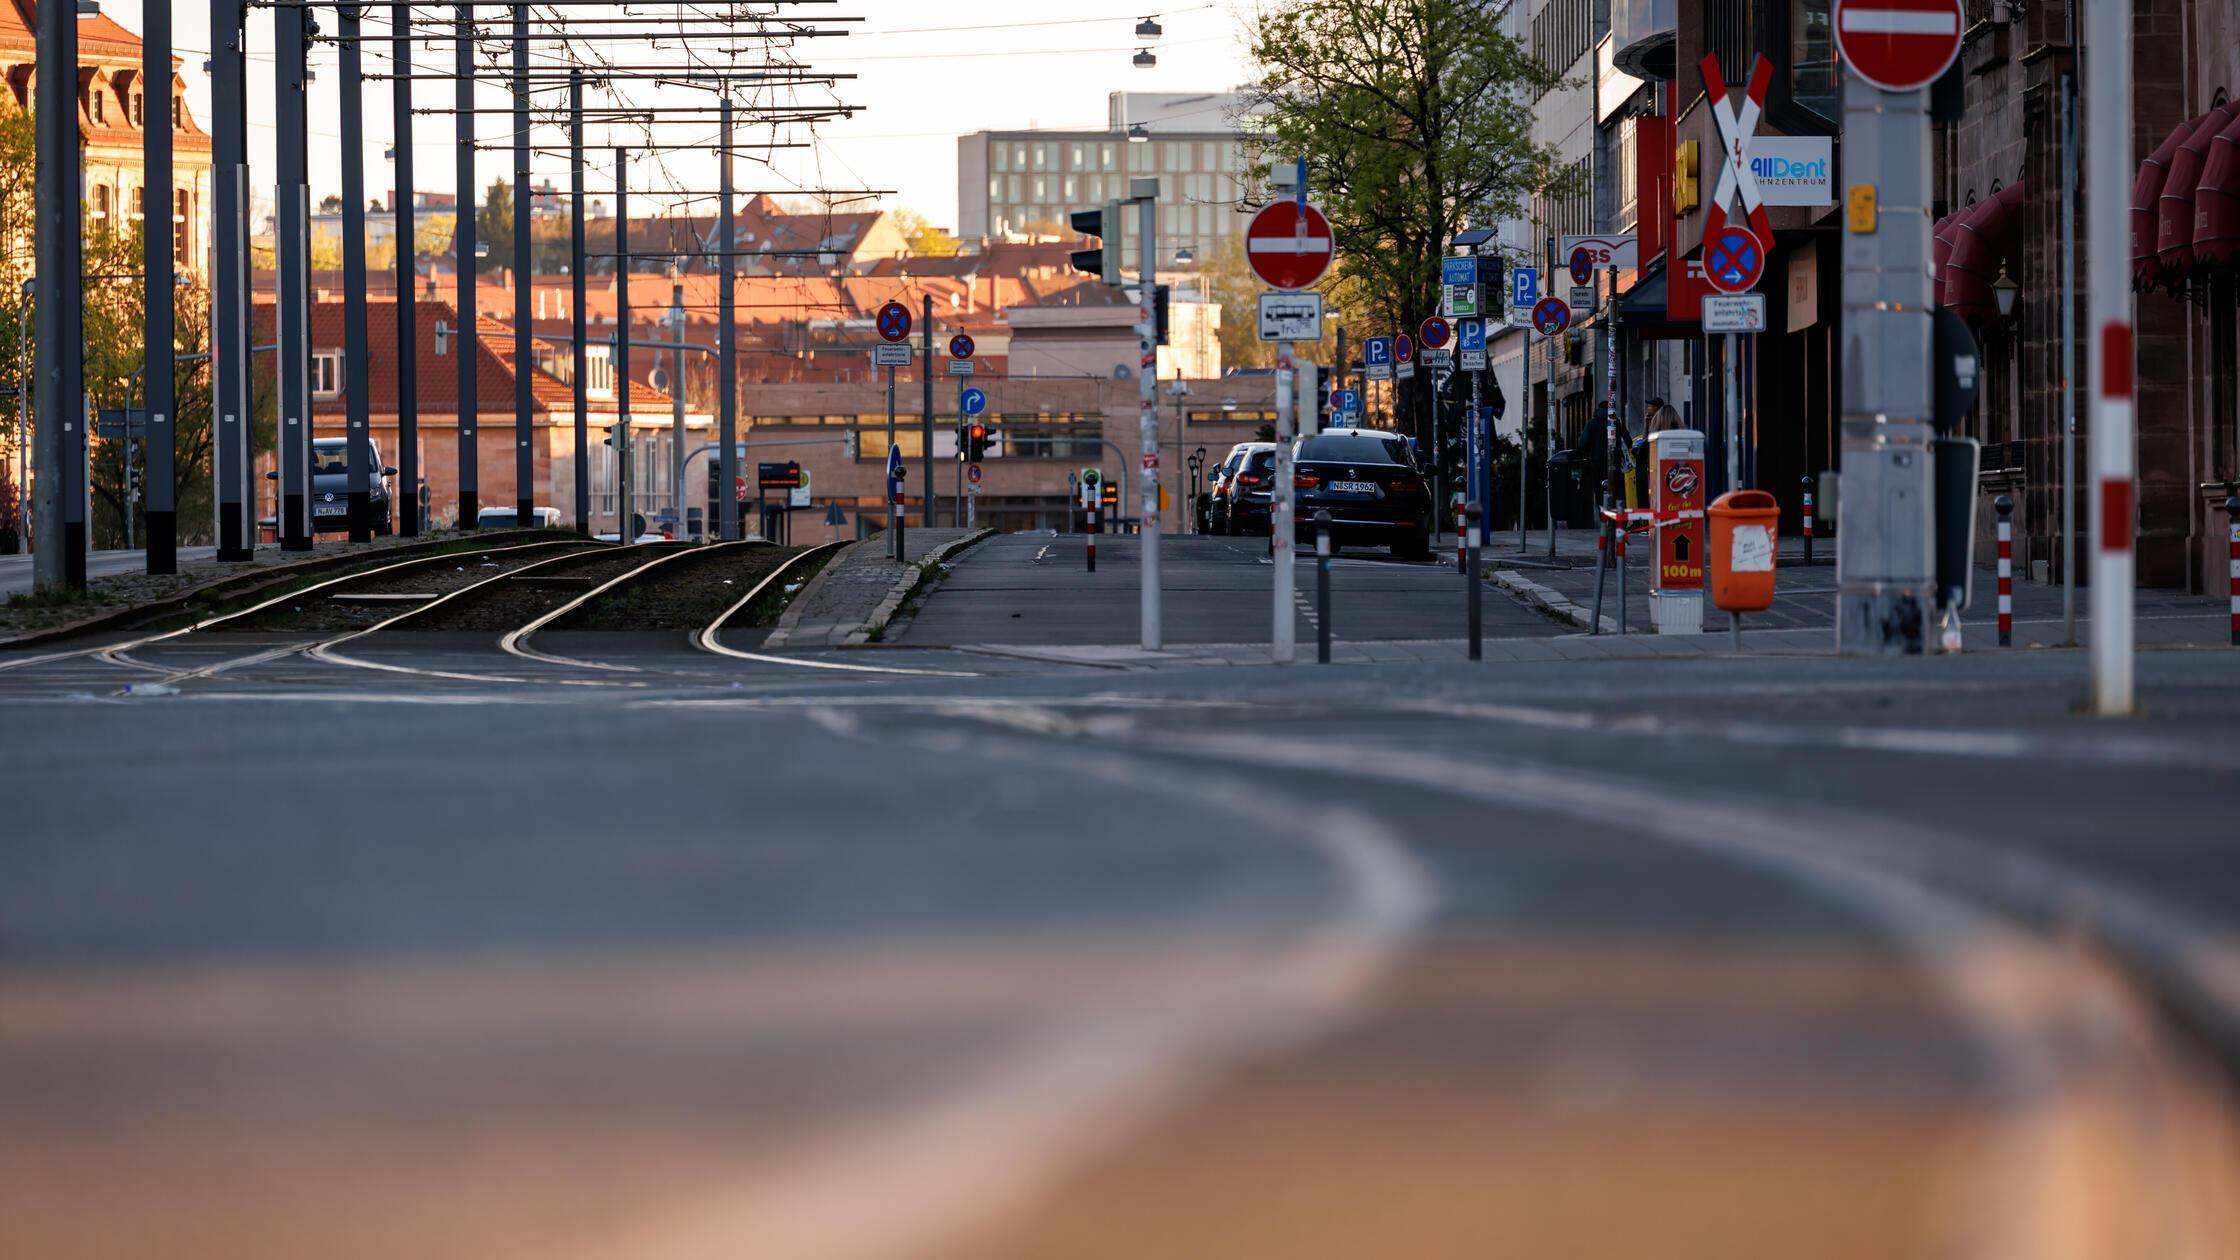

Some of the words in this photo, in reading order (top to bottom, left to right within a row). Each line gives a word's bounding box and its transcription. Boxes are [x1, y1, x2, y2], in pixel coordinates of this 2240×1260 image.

[1448, 272, 1471, 283] AUTOMAT
[1517, 273, 1530, 302] P
[1466, 321, 1480, 339] P
[1371, 340, 1383, 362] P
[1344, 392, 1354, 409] P
[1355, 483, 1374, 491] 1962
[1663, 565, 1689, 577] 100
[1690, 568, 1702, 577] m
